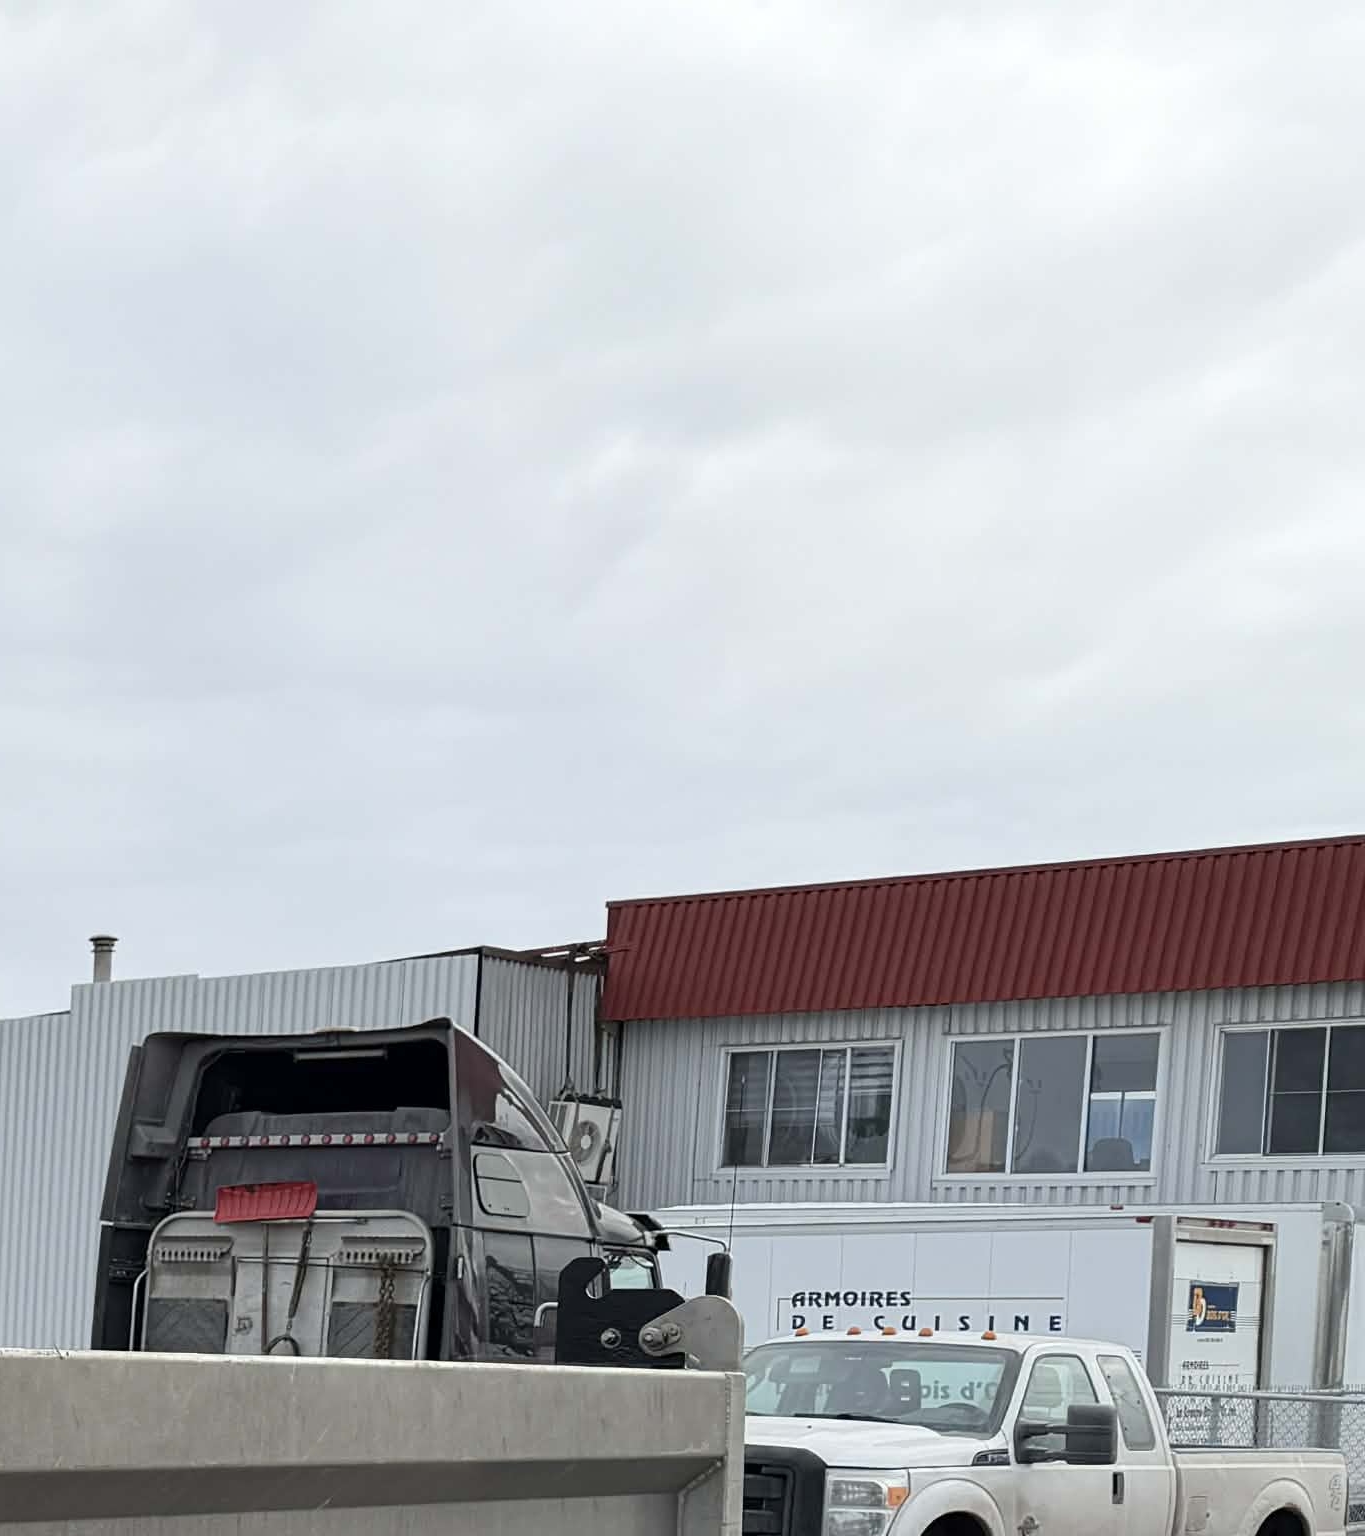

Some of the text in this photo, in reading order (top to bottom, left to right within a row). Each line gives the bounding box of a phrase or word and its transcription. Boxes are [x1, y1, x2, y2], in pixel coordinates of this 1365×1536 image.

[791, 1291, 912, 1308] ARMOIRES
[792, 1315, 1063, 1332] DE CUISINE
